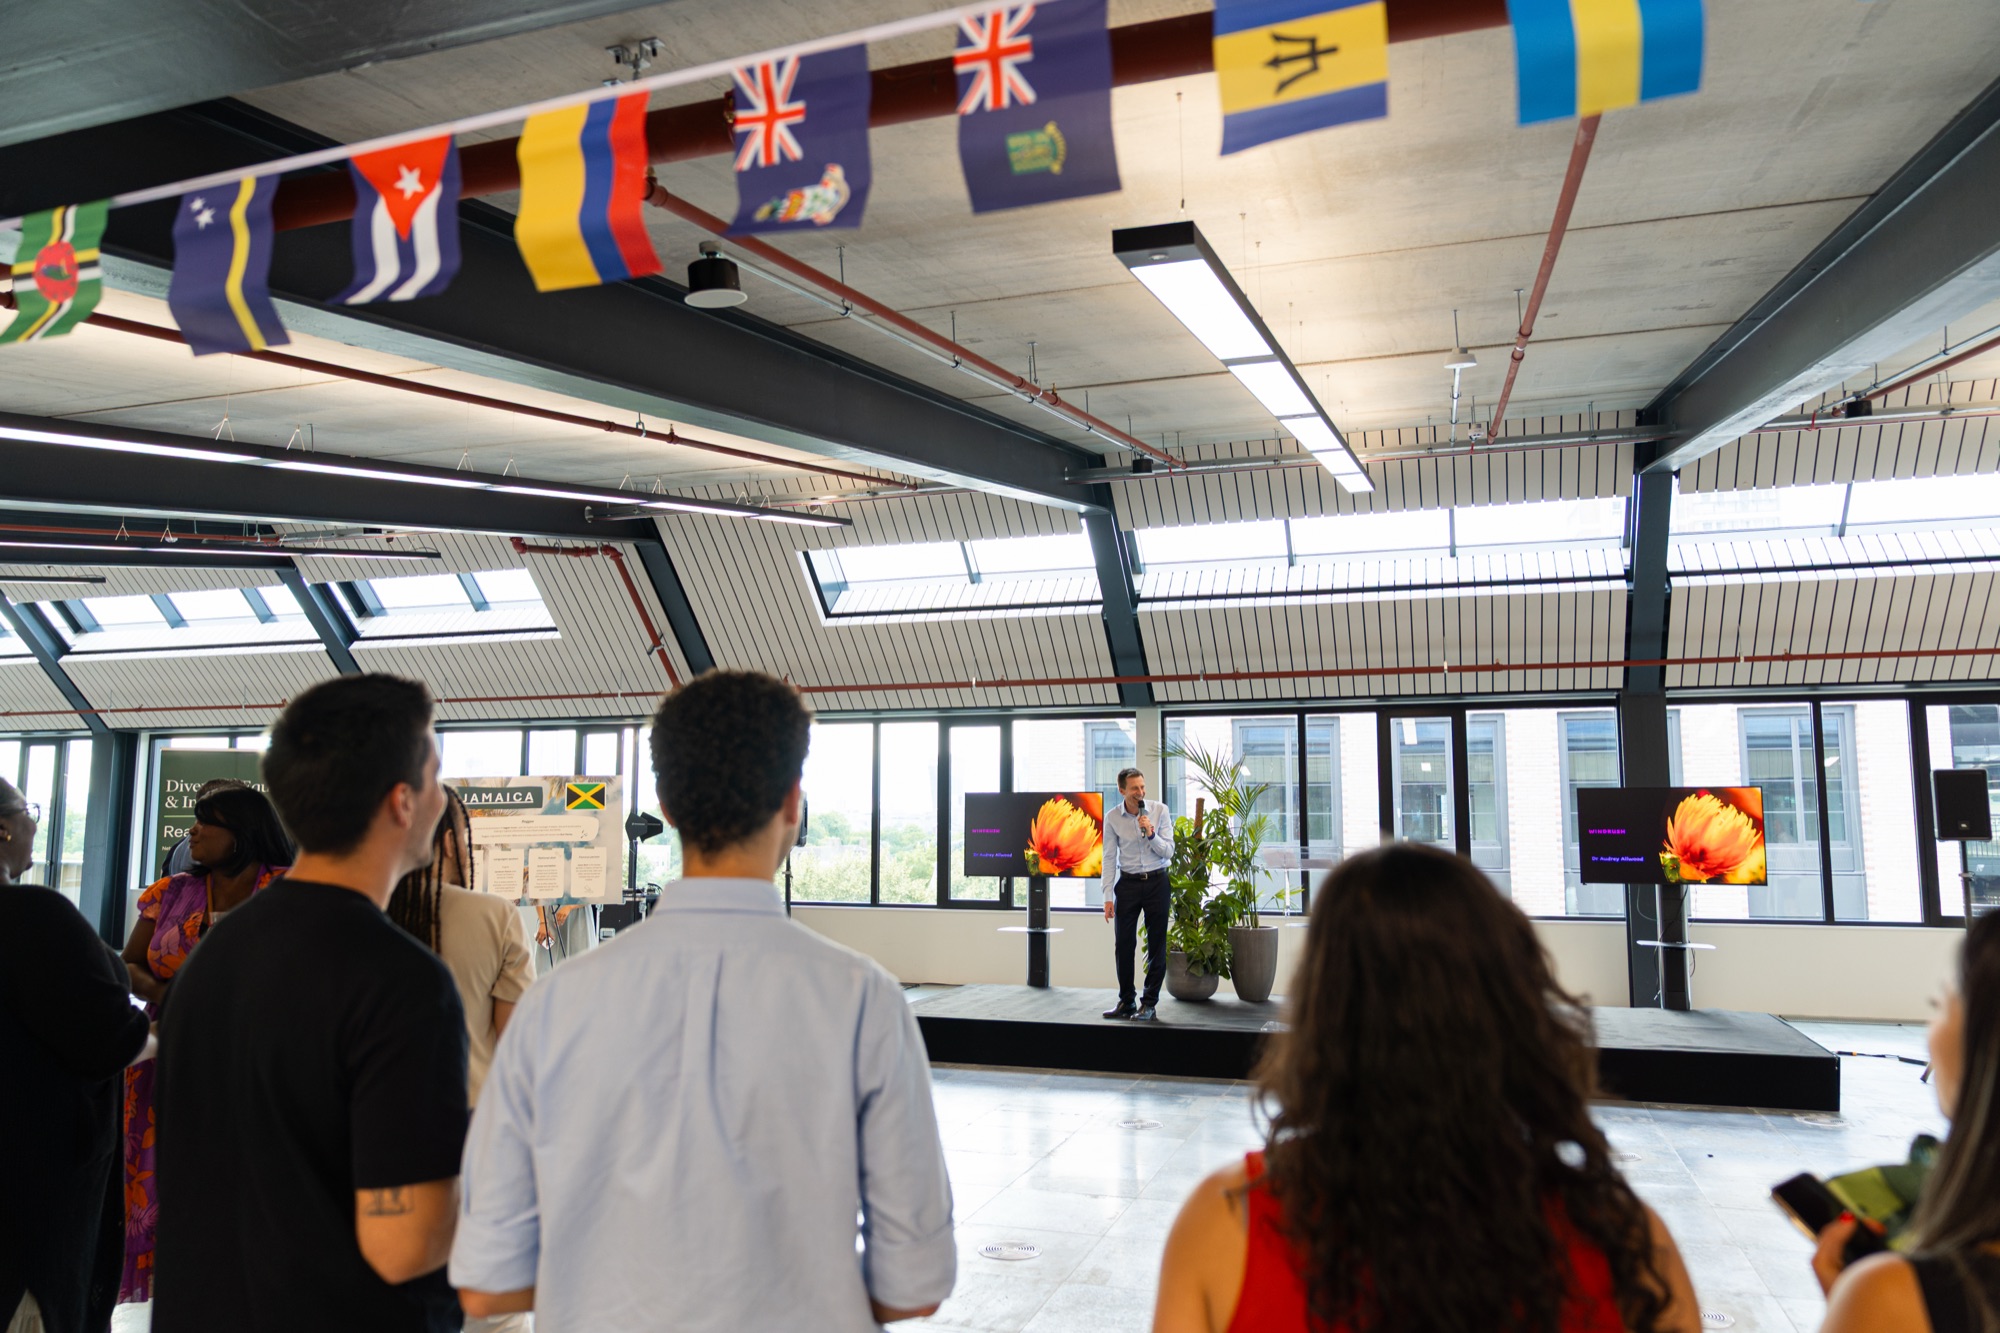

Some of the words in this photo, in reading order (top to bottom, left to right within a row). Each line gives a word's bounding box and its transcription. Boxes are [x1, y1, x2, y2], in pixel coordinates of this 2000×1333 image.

[165, 779, 204, 793] Dive
[164, 795, 179, 809] &
[182, 795, 197, 809] In
[463, 791, 534, 804] JAMAICA
[163, 825, 190, 838] Rea
